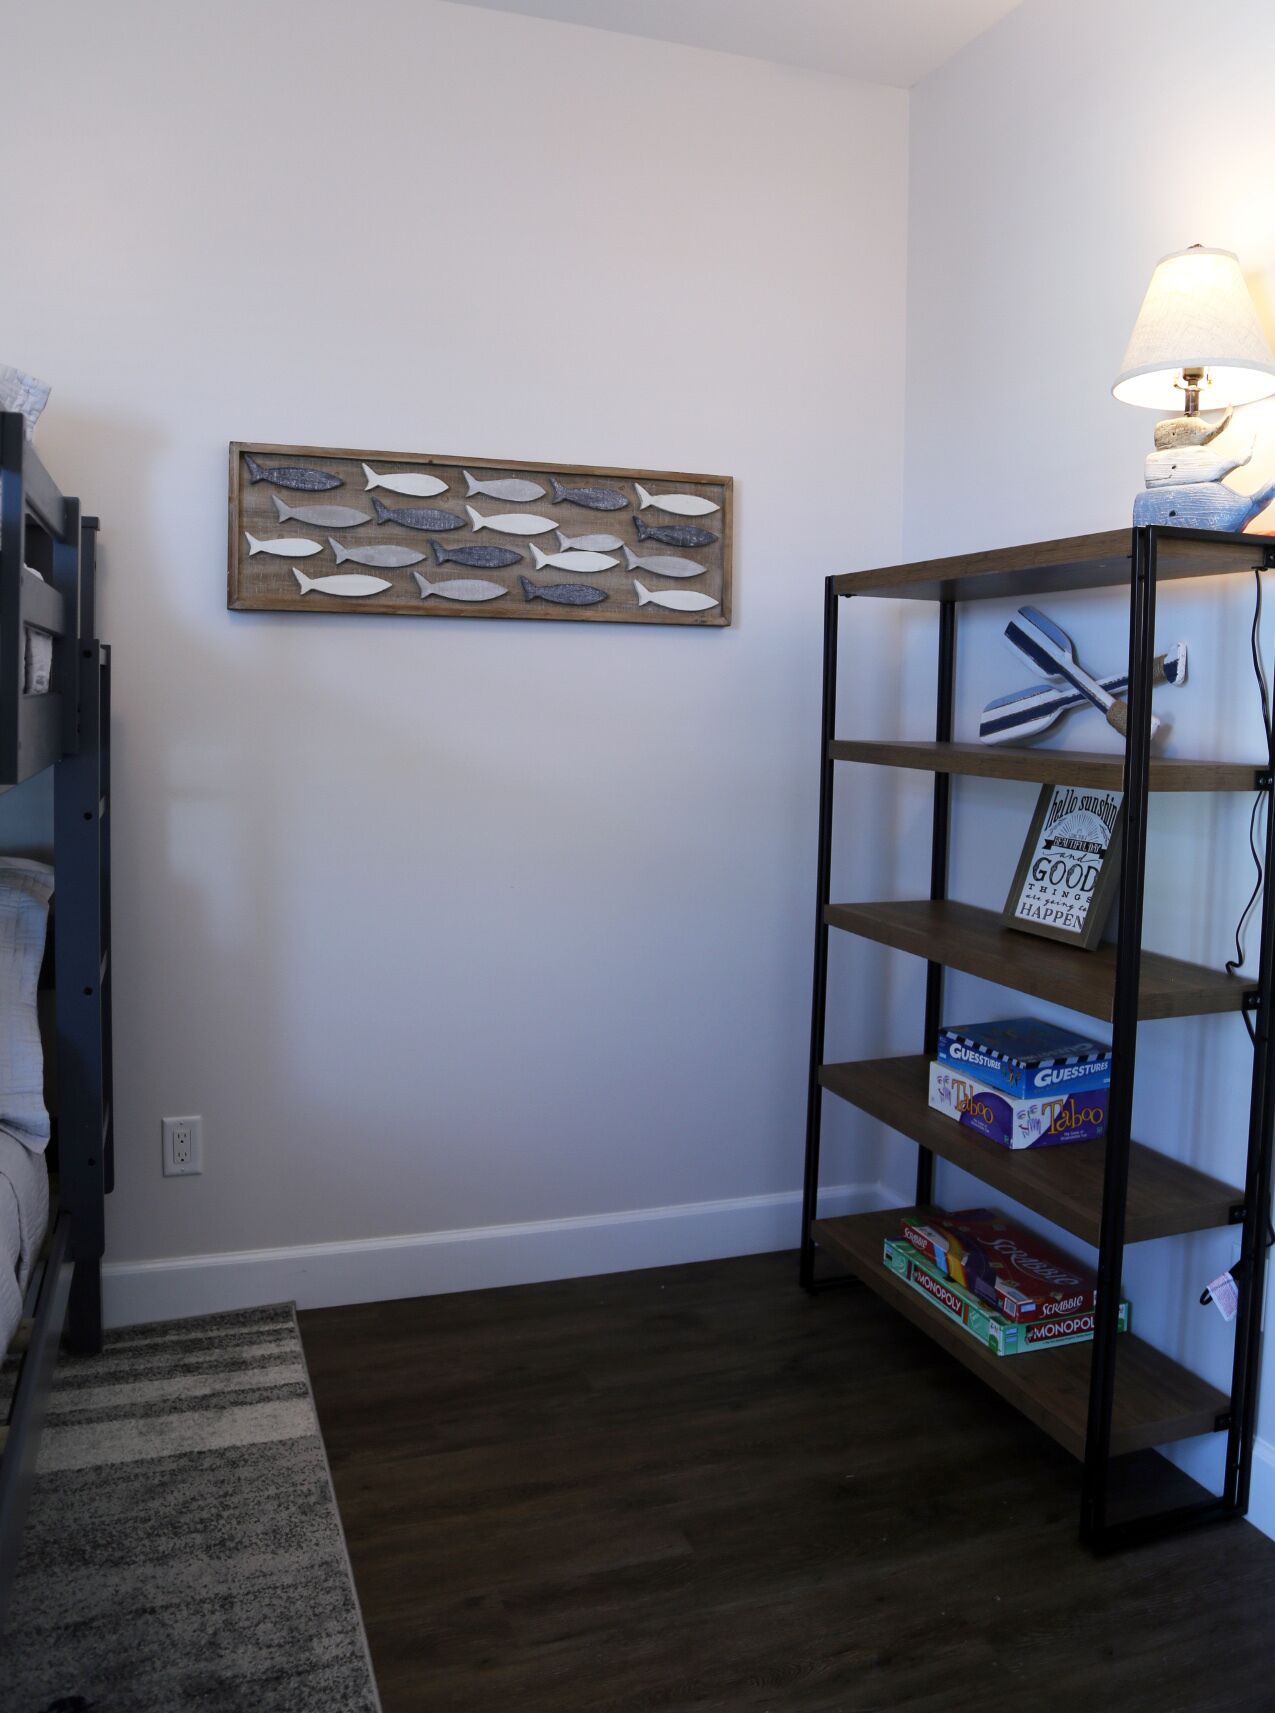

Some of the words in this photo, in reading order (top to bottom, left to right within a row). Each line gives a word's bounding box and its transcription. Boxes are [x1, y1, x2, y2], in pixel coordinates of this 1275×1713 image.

[1045, 789, 1078, 831] hello
[1079, 793, 1118, 833] sunshin
[1047, 852, 1096, 863] and
[1032, 857, 1099, 892] GOOD
[1028, 883, 1093, 904] THINGS
[1042, 897, 1074, 911] going
[1020, 902, 1086, 930] HAPPEN
[949, 1043, 1001, 1070] GUESSTURES
[1033, 1061, 1109, 1088] GUESSTURES
[951, 1078, 994, 1125] Taboo
[1041, 1098, 1104, 1135] Taboo
[915, 1271, 962, 1312] MONOPOLY
[1033, 1316, 1095, 1340] MONOPOL
